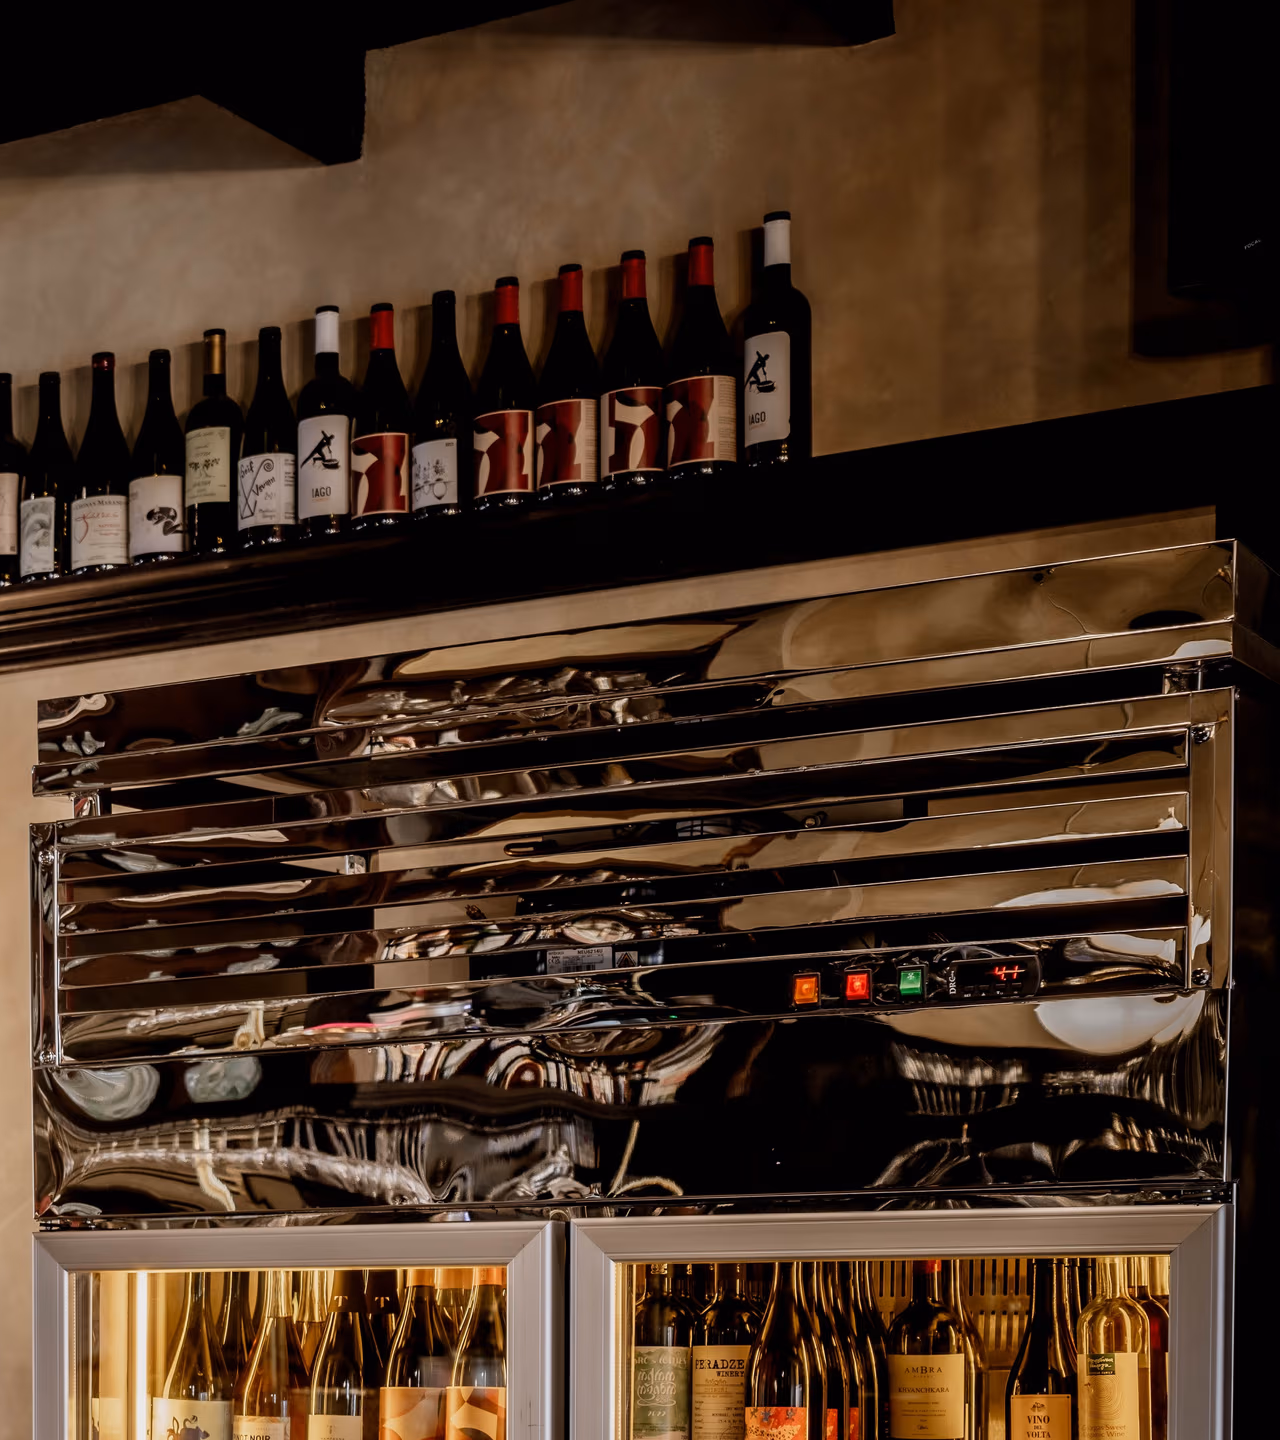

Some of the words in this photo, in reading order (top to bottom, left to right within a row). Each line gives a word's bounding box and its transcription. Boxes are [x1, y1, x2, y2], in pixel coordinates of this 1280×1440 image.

[748, 411, 766, 426] IAGO
[311, 486, 332, 498] IAGO
[695, 1358, 745, 1370] PERADZE
[716, 1370, 745, 1378] WINERY
[904, 1365, 943, 1375] AMBRA
[1026, 1415, 1051, 1424] VINO
[1026, 1431, 1051, 1439] VOLTA
[1106, 1430, 1125, 1438] Wine
